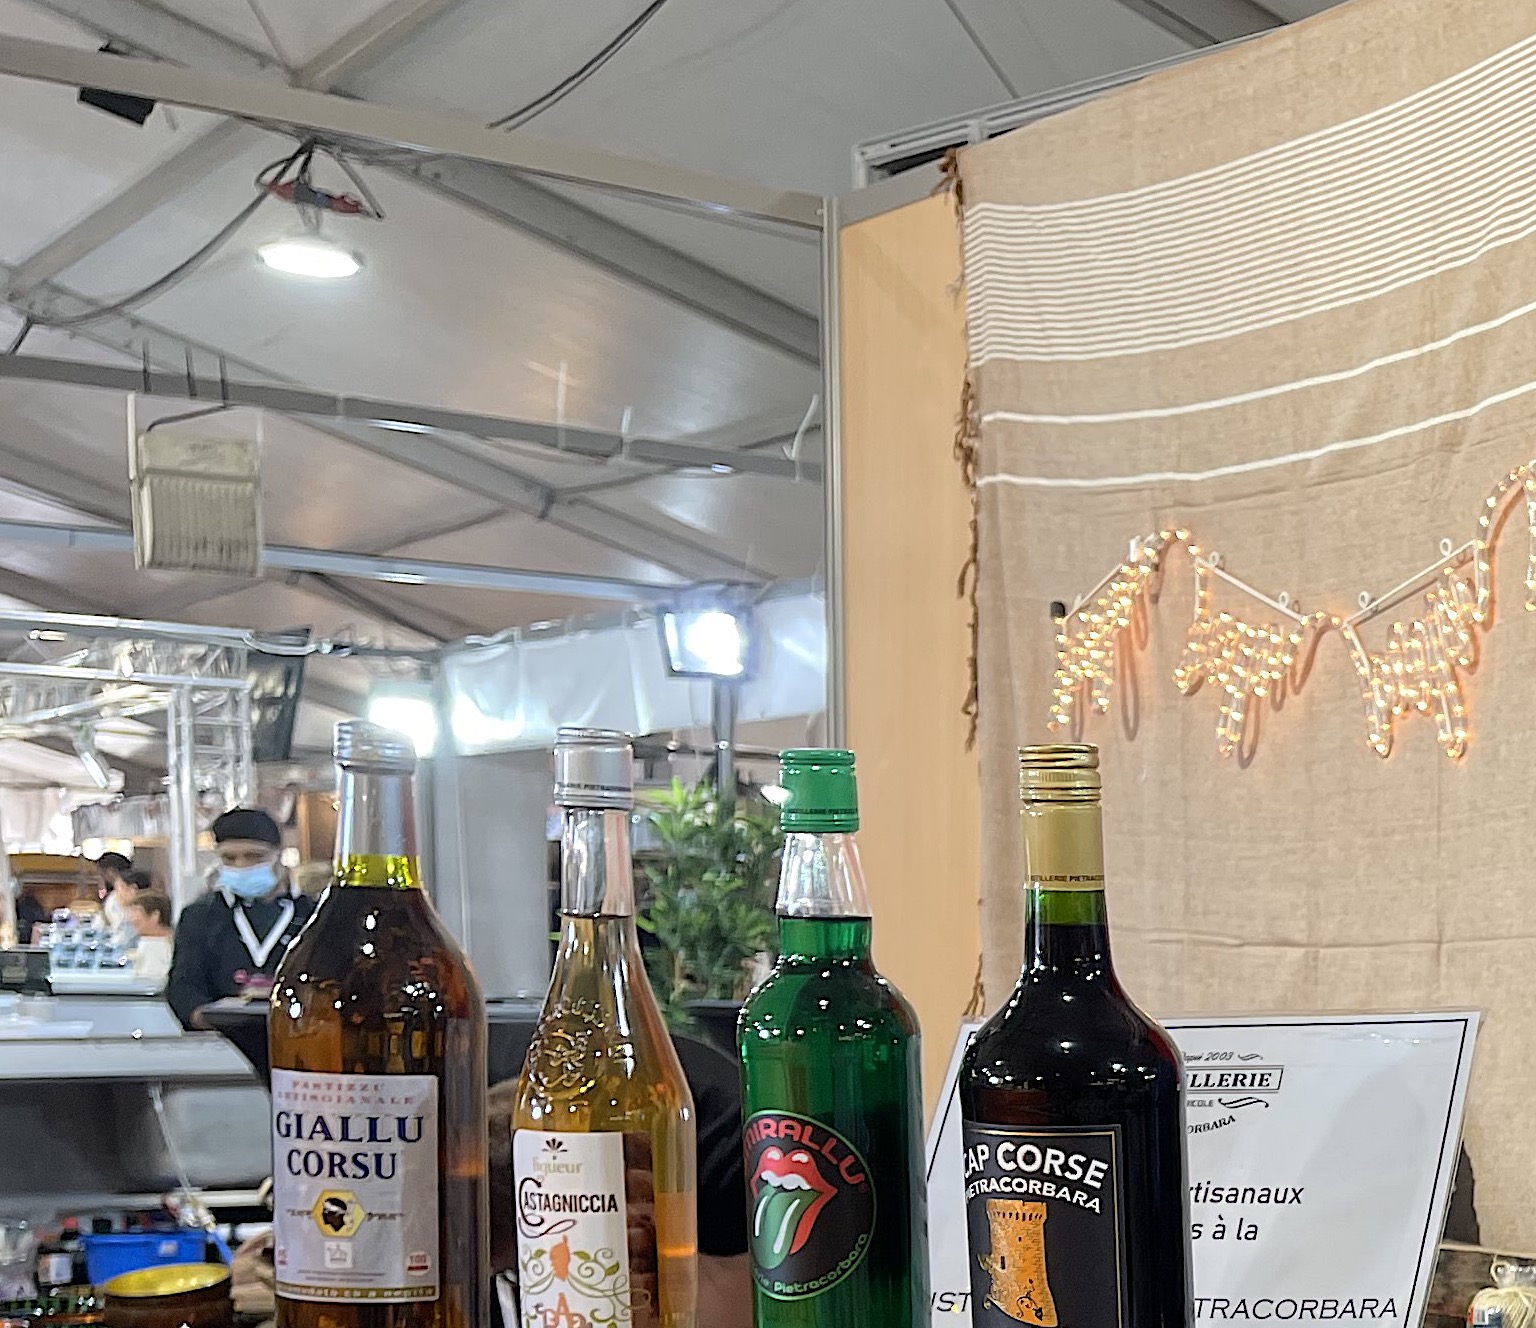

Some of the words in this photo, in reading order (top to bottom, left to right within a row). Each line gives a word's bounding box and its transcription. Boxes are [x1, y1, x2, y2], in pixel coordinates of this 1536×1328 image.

[1204, 1051, 1235, 1061] 2003
[1186, 1072, 1272, 1088] LLERIE
[276, 1110, 425, 1143] GIALLU
[287, 1149, 397, 1180] CORSU
[996, 1141, 1109, 1190] CORSE
[518, 1177, 618, 1228] CASTAGNICCIA
[1189, 1180, 1305, 1204] tisanaux
[1212, 1214, 1226, 1240] à
[1236, 1217, 1258, 1241] la
